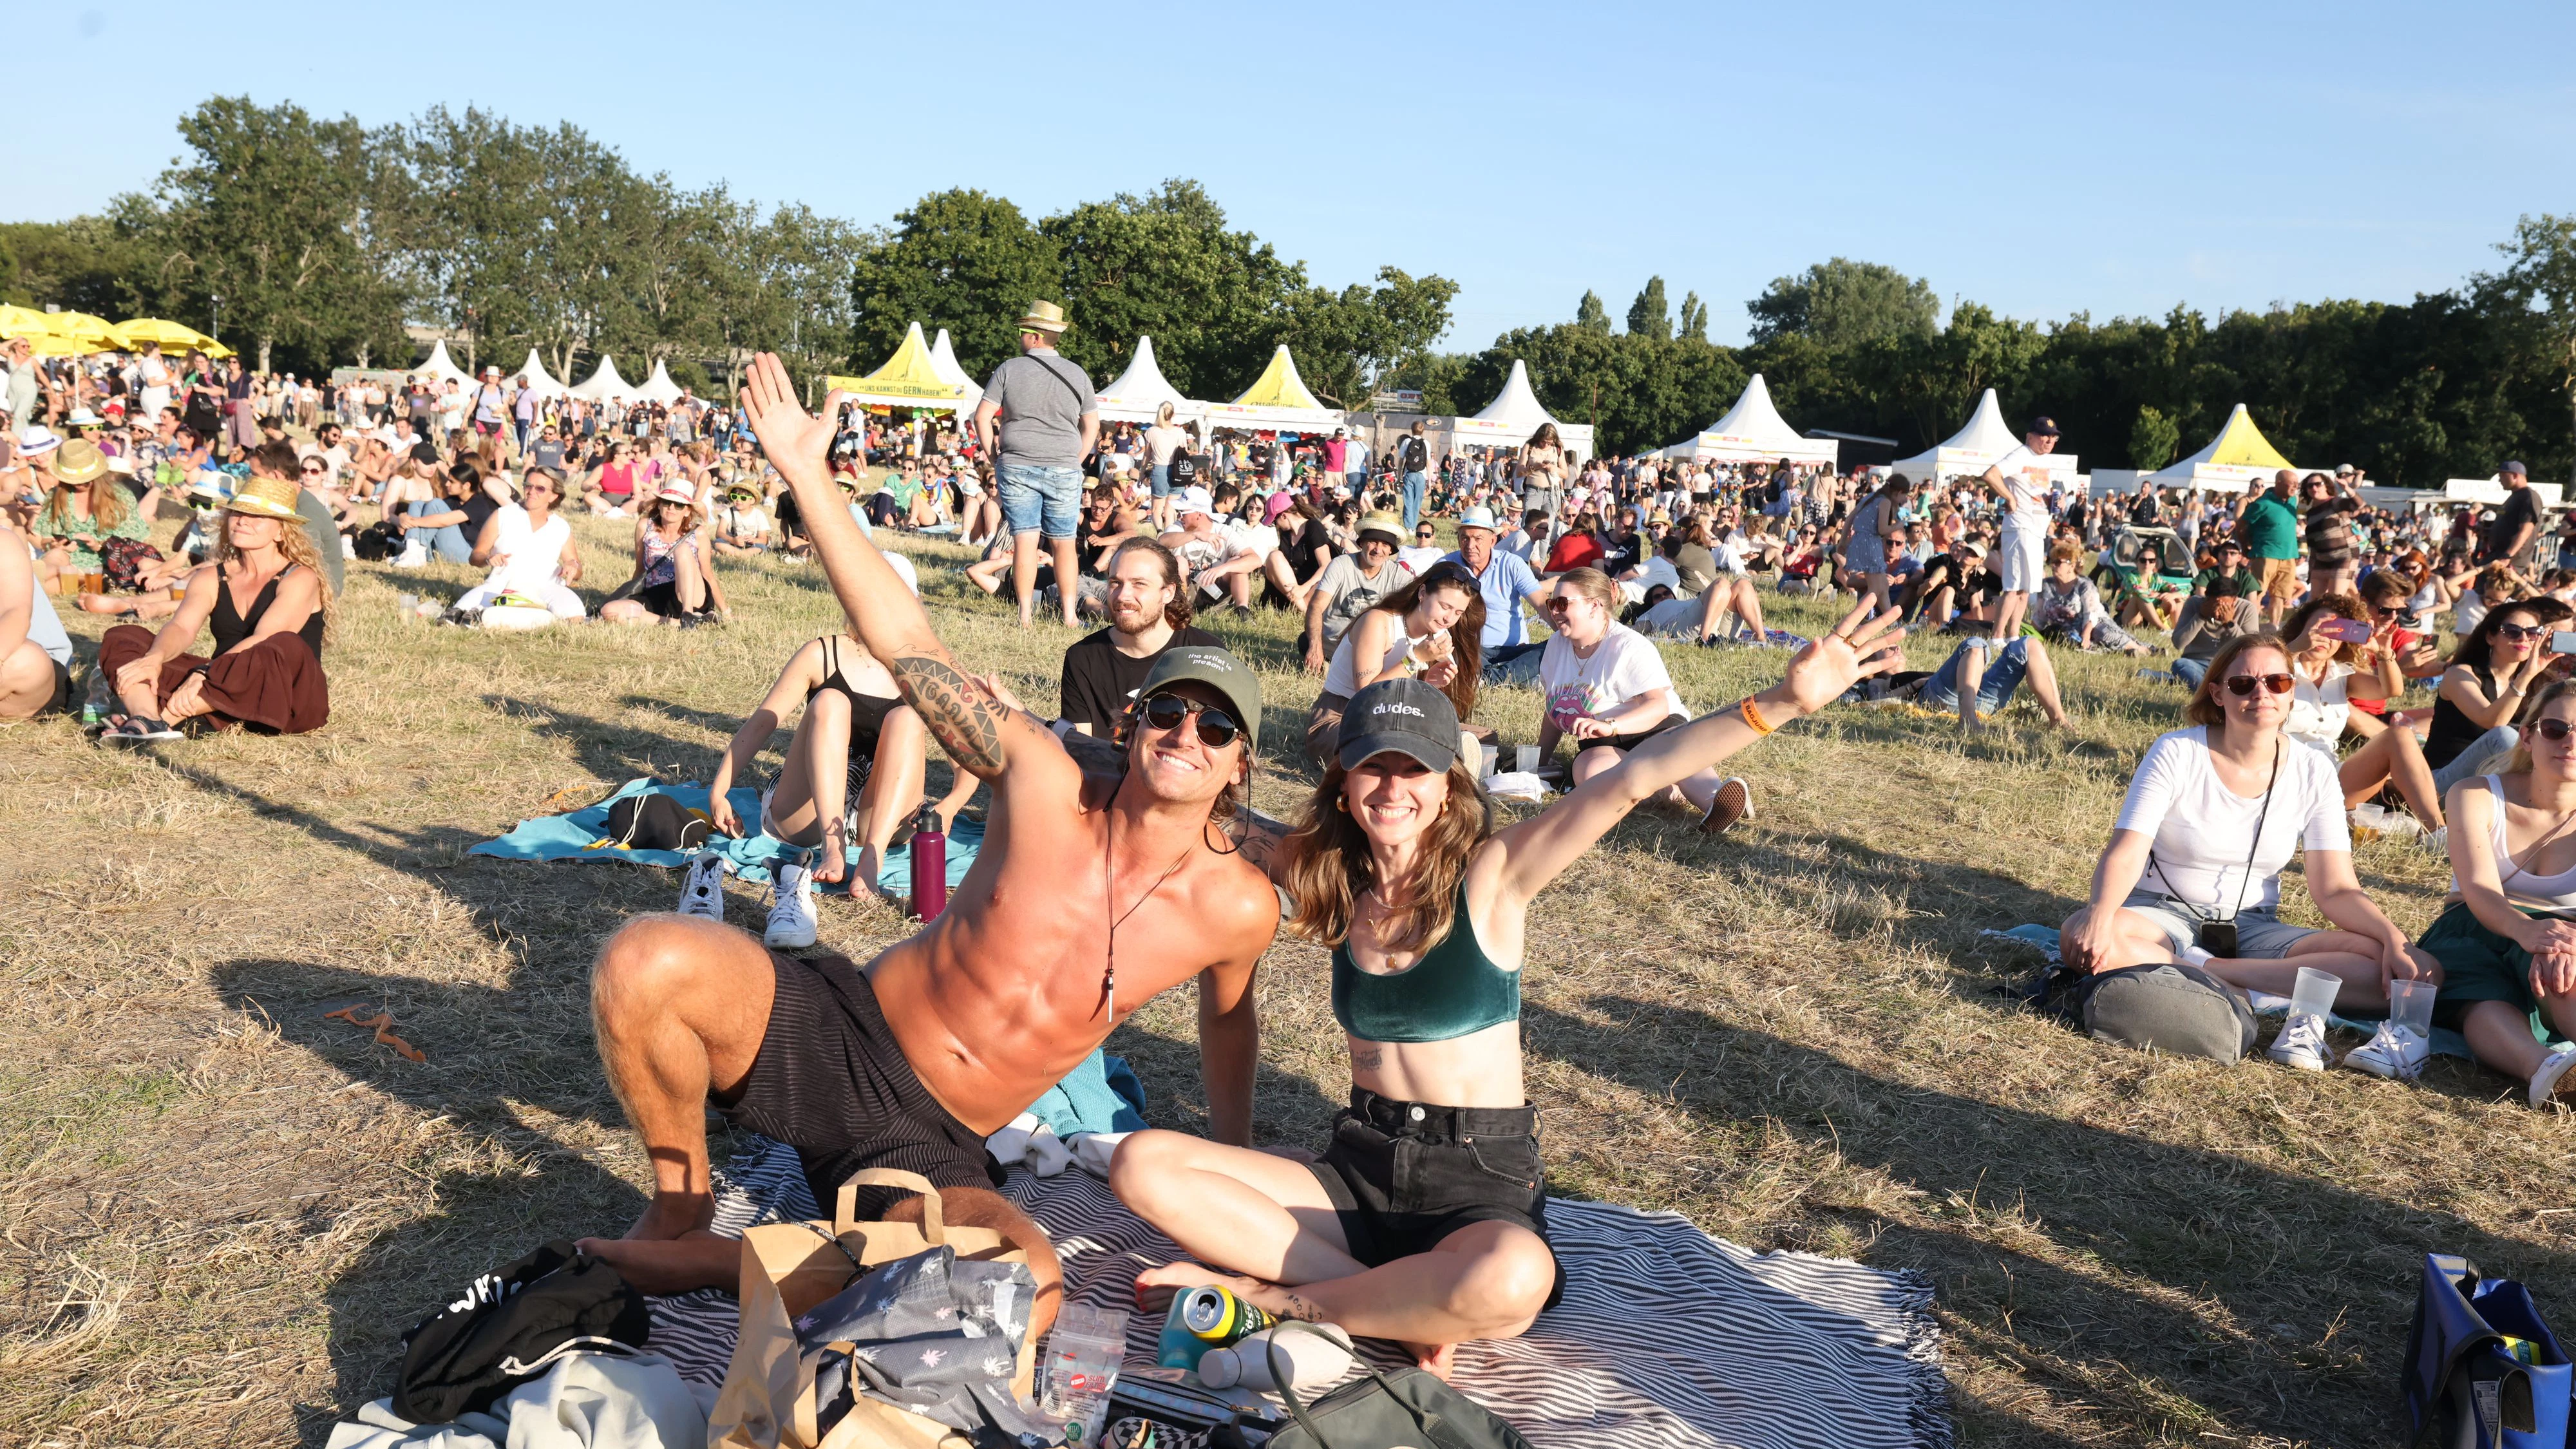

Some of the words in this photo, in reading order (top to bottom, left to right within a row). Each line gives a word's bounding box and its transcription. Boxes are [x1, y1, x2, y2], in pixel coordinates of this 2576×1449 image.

[904, 385, 922, 395] GERN
[1192, 659, 1224, 672] present
[1203, 654, 1226, 666] artist
[1226, 663, 1232, 671] is
[1372, 701, 1425, 717] dudes.
[1745, 705, 1767, 732] BAGJUMP
[817, 1228, 836, 1242] BRUNOTTI
